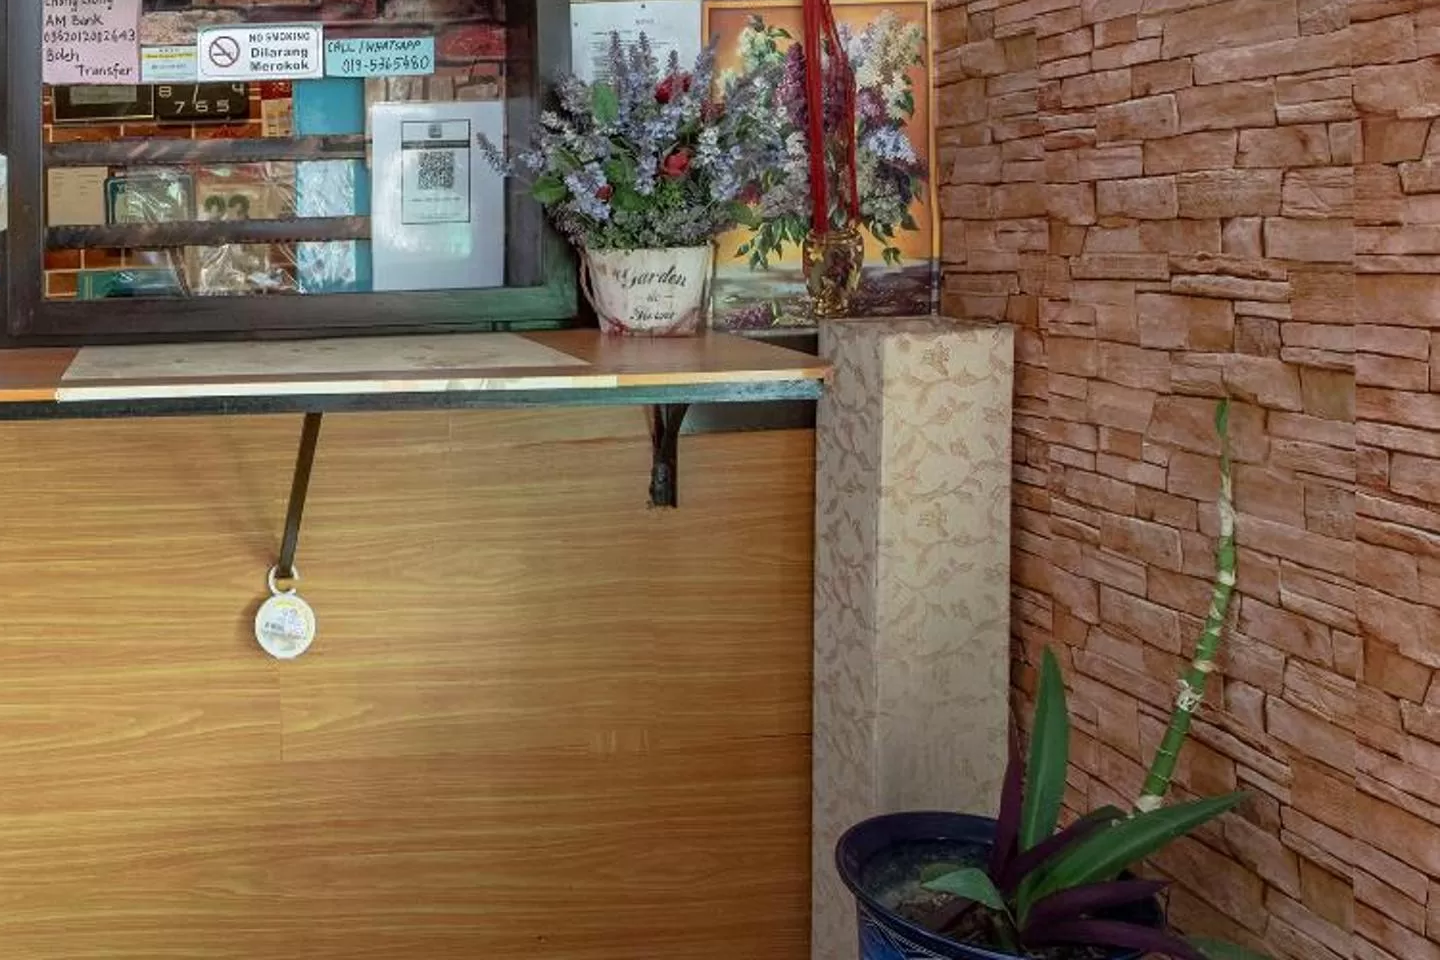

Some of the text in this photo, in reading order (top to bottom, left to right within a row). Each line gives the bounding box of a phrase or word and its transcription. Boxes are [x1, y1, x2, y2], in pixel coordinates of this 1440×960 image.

[46, 14, 66, 27] AM
[249, 32, 310, 43] NO SMOKING
[251, 47, 309, 58] Dilarang
[328, 41, 355, 53] CALL
[75, 63, 132, 79] Transfer
